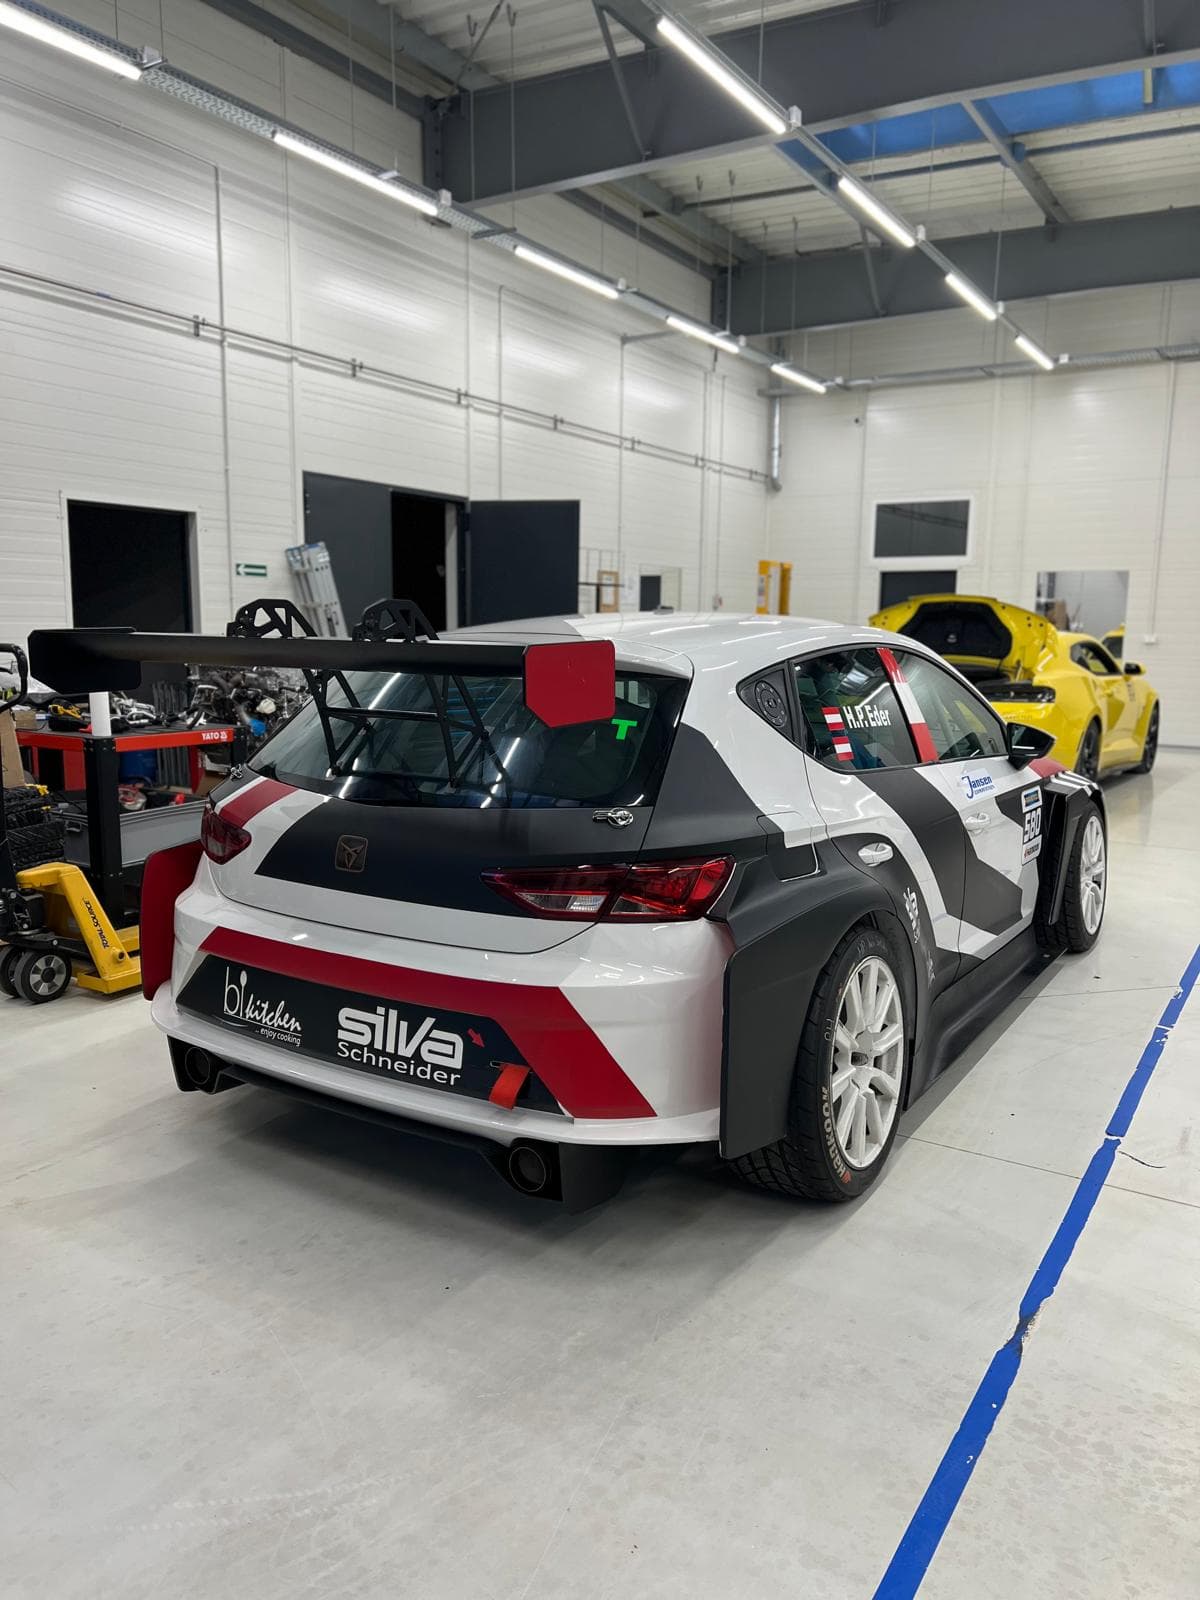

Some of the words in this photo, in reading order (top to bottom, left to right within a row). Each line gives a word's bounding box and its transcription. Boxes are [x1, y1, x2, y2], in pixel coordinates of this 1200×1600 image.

[202, 731, 220, 741] YATO
[611, 718, 638, 740] T
[961, 775, 993, 799] Jansen
[245, 993, 302, 1031] kitchen
[277, 1033, 301, 1047] cooking
[337, 1041, 461, 1085] Schneider
